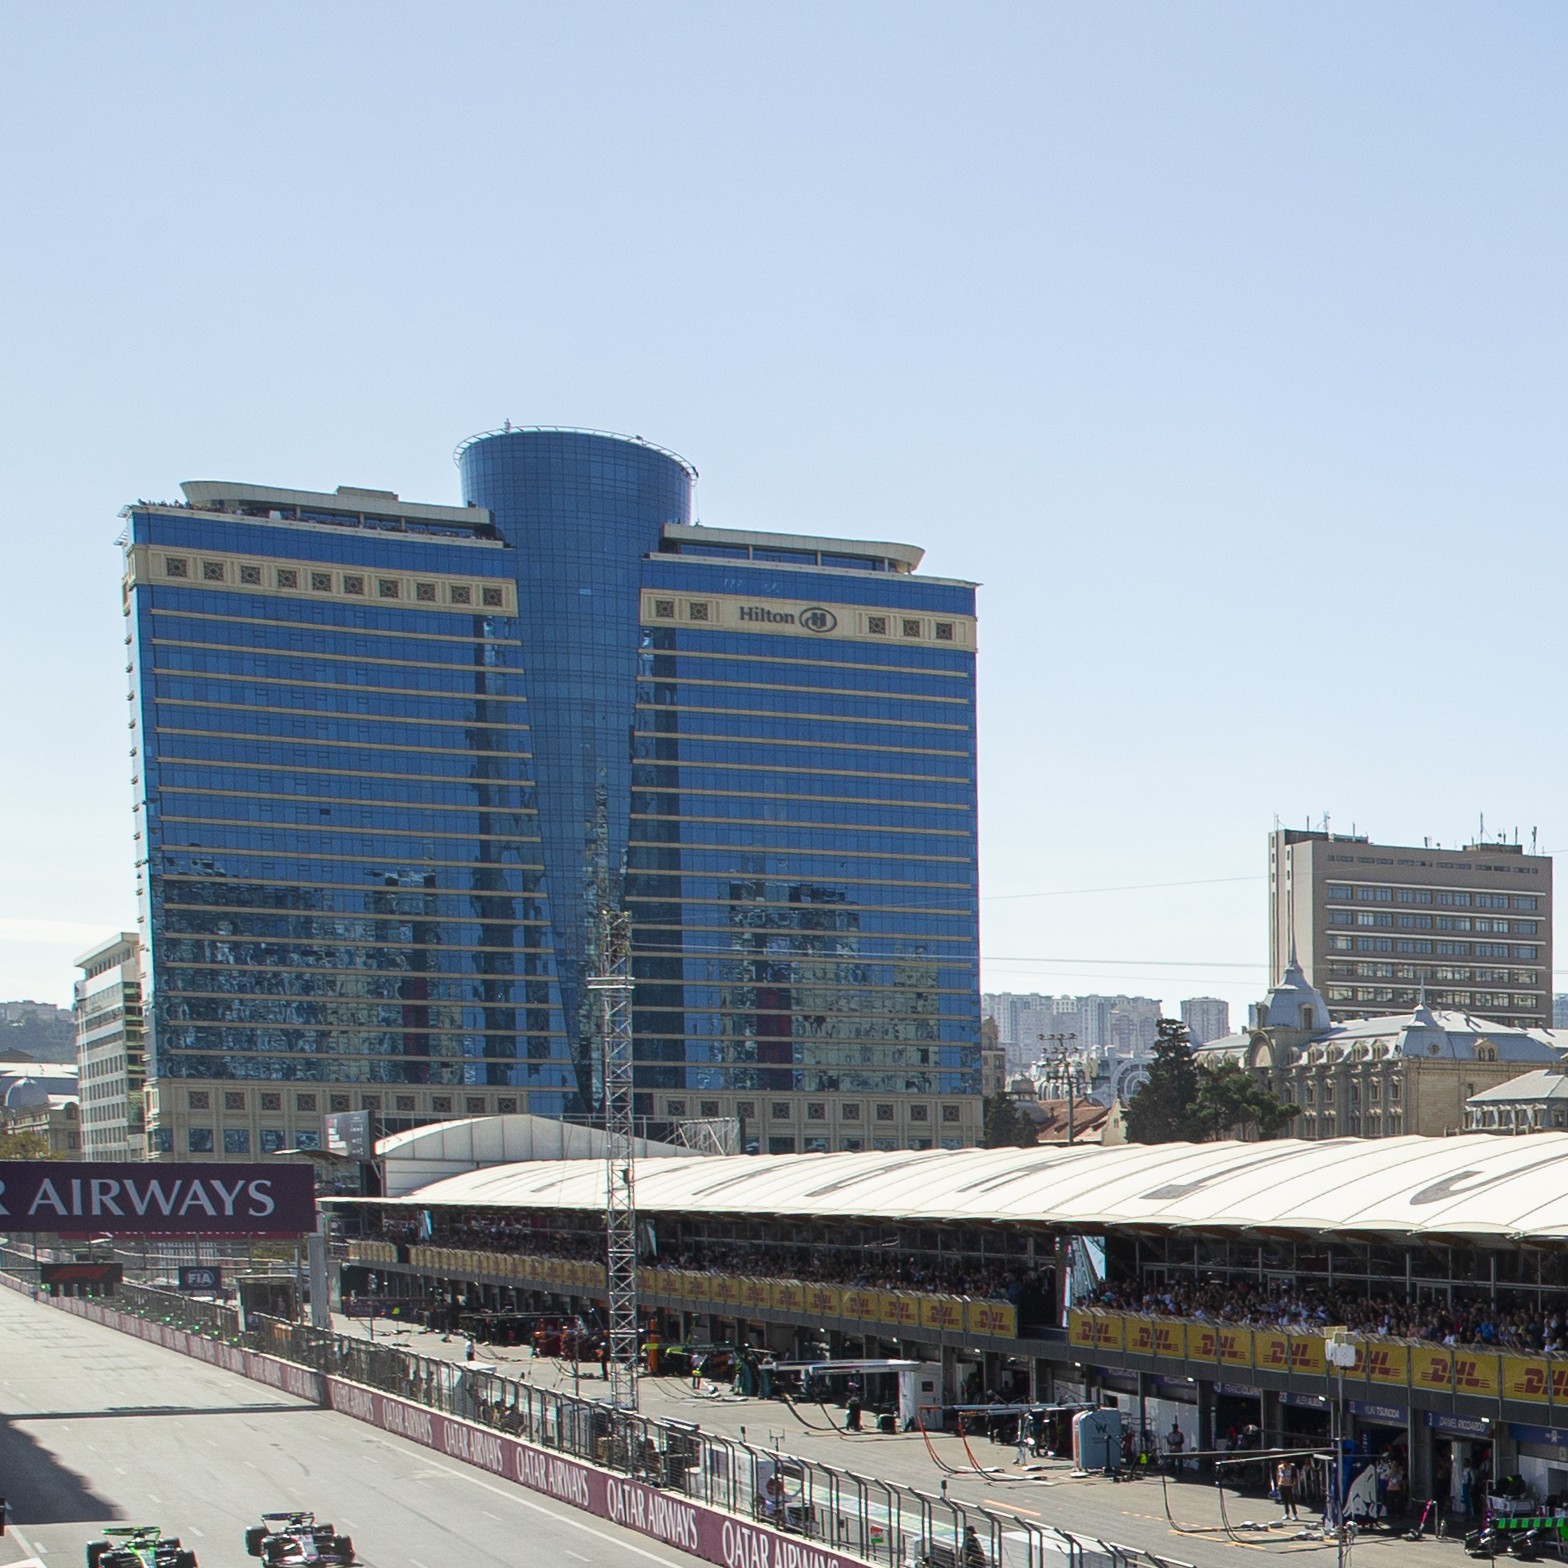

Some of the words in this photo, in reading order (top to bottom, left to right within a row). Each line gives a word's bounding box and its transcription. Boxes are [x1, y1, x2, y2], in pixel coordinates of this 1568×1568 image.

[739, 606, 795, 625] Hilton
[28, 1178, 275, 1217] AIRWAYS
[188, 1273, 214, 1285] FIA
[1081, 1321, 1112, 1346] DHL
[1138, 1326, 1173, 1352] DHL
[1200, 1332, 1238, 1359] DHL
[1269, 1341, 1312, 1368] DHL
[1431, 1357, 1480, 1388] DHL
[443, 1420, 470, 1457] QATAR
[471, 1428, 503, 1471] AIRWAYS
[516, 1446, 547, 1486] QATAR
[549, 1459, 590, 1507] AIRWAYS
[606, 1477, 643, 1528] QATAR
[645, 1493, 698, 1551] AIRWAYS
